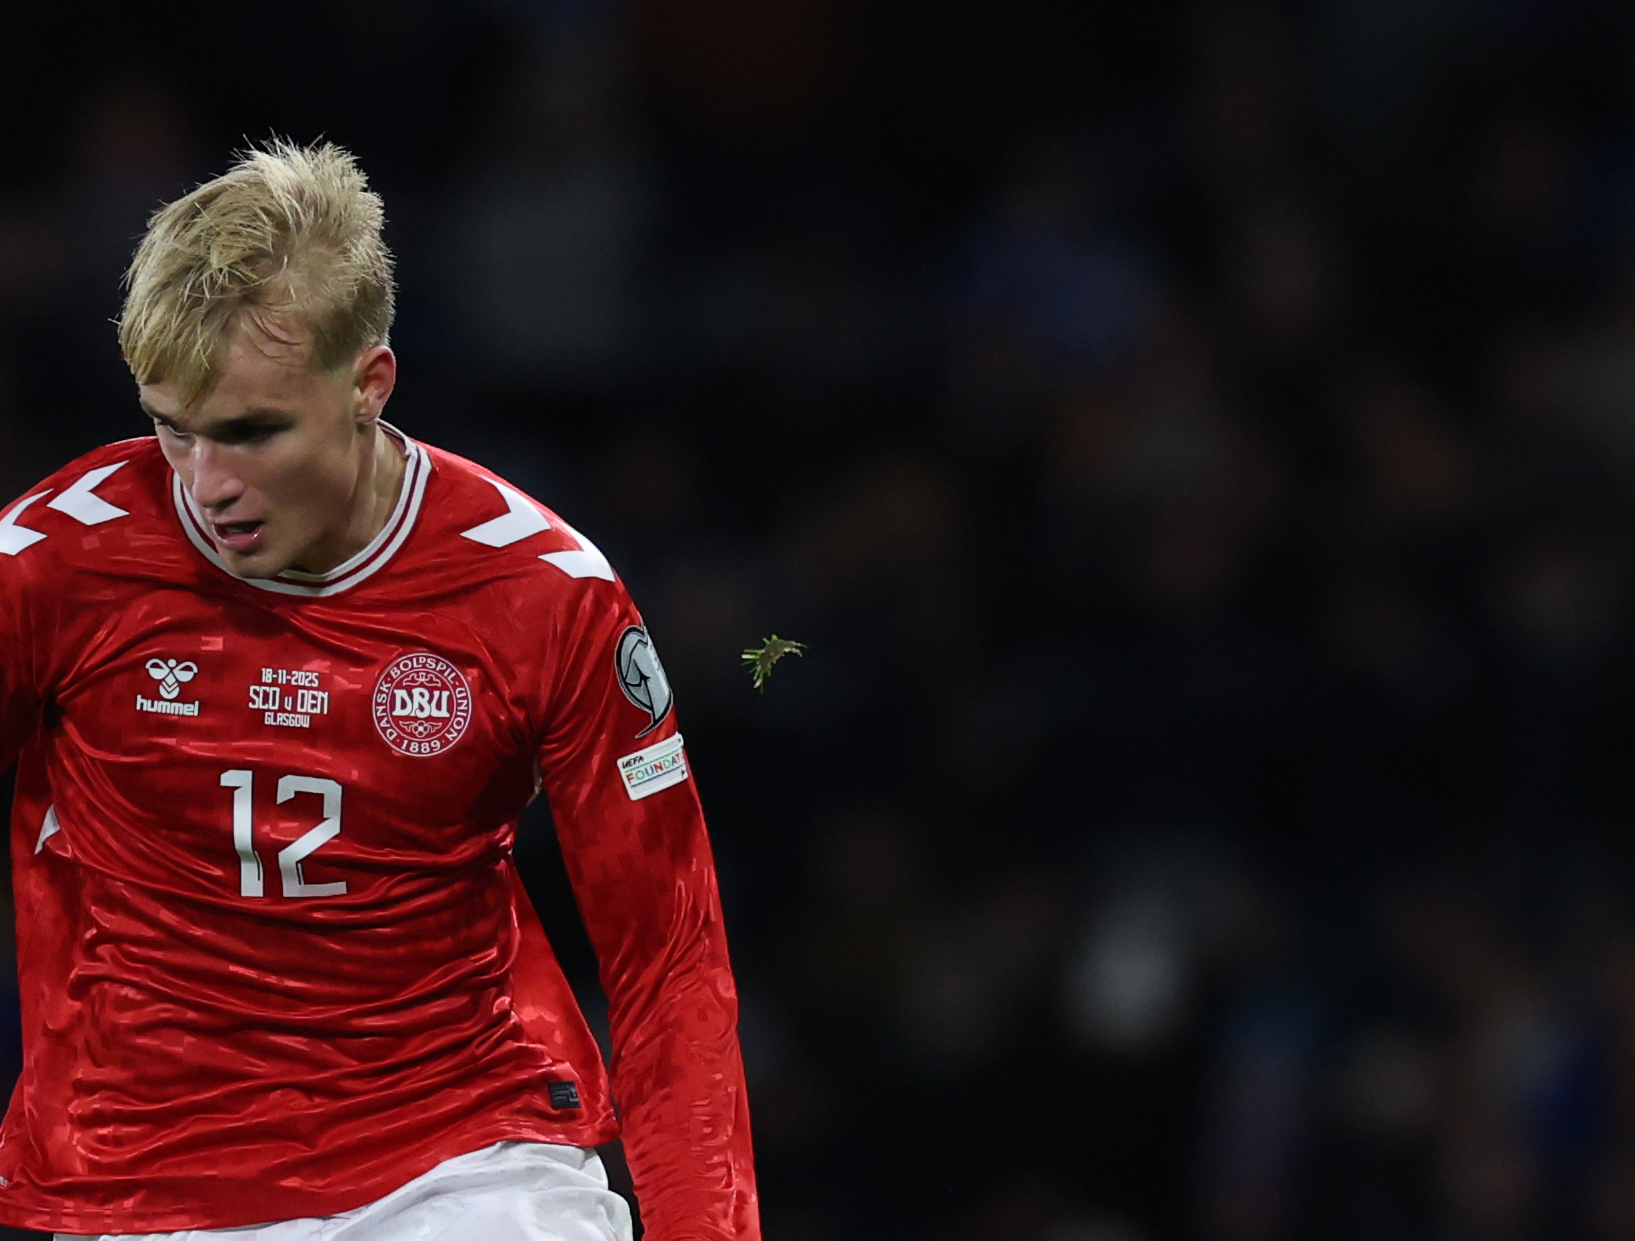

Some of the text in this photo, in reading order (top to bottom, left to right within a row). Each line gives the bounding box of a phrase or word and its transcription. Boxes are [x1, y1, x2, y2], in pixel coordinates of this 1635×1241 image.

[261, 667, 320, 688] 18-11-2025
[136, 694, 200, 717] hummel
[248, 685, 281, 711] SCO
[296, 689, 329, 715] DEN
[391, 687, 451, 719] DBU
[264, 711, 311, 729] GLASGOW
[376, 681, 398, 741] DANSK
[401, 739, 442, 754] 1889
[622, 755, 644, 770] UEFA
[626, 752, 684, 783] FOUNDAT
[219, 769, 348, 898] 12
